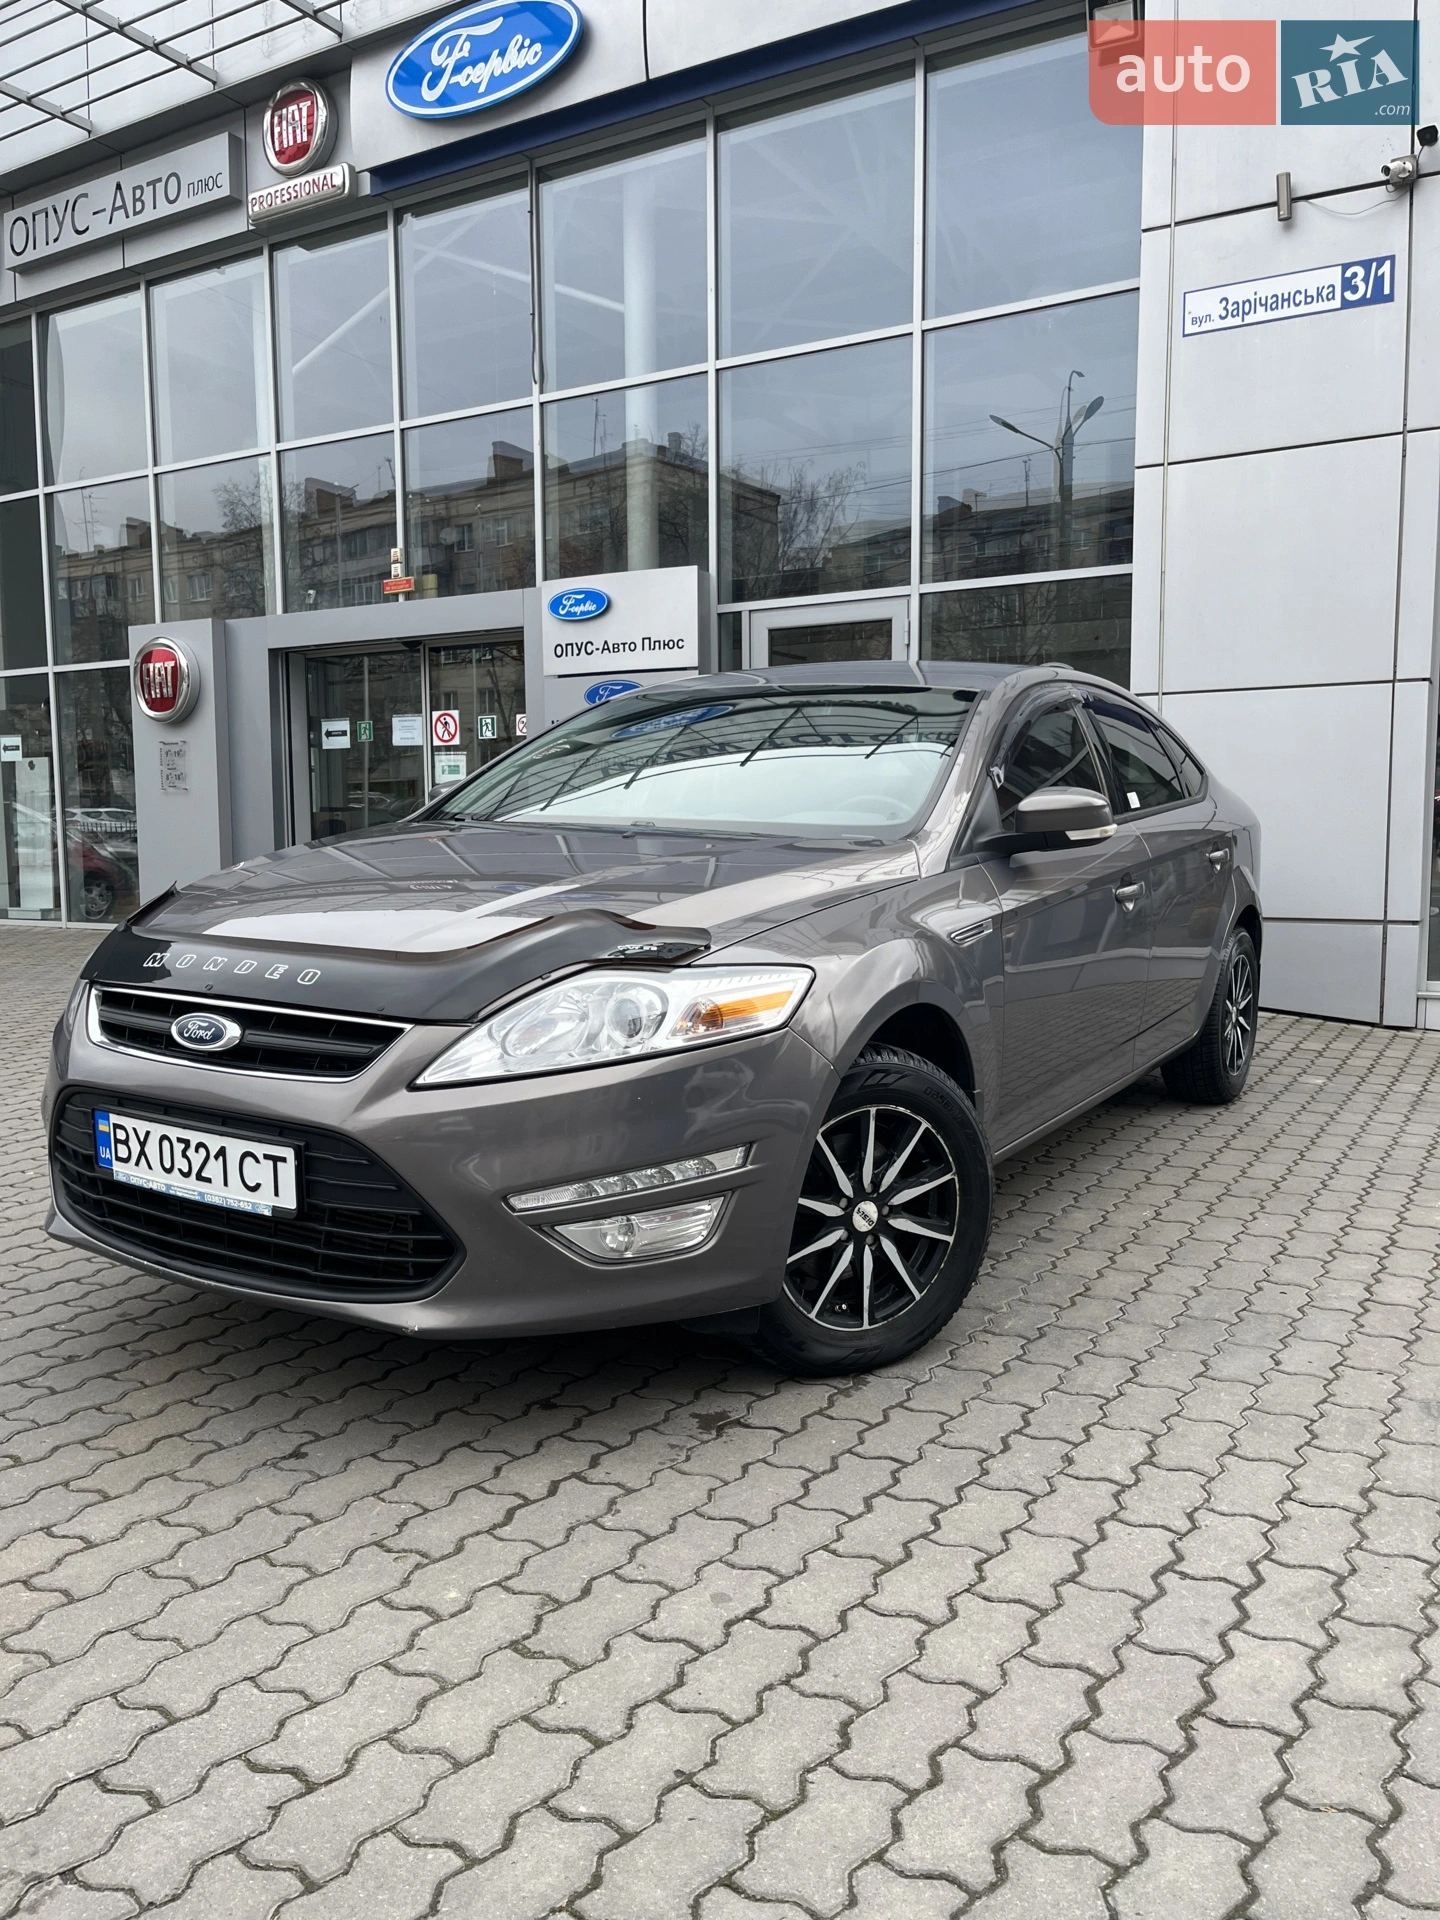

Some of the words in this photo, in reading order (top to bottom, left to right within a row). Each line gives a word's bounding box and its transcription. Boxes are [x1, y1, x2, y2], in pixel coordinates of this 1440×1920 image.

[274, 100, 312, 152] FIAT
[250, 172, 337, 212] PROFESSIONAL
[1190, 313, 1215, 328] вул.
[1218, 282, 1336, 323] Зарічанська
[1343, 258, 1392, 302] 3/1
[553, 639, 637, 659] ОПУС-Авто
[641, 636, 685, 652] Плюс
[142, 660, 176, 699] FIAT
[142, 952, 322, 985] MONDEO
[183, 1019, 215, 1041] Ford
[99, 1145, 112, 1161] UA
